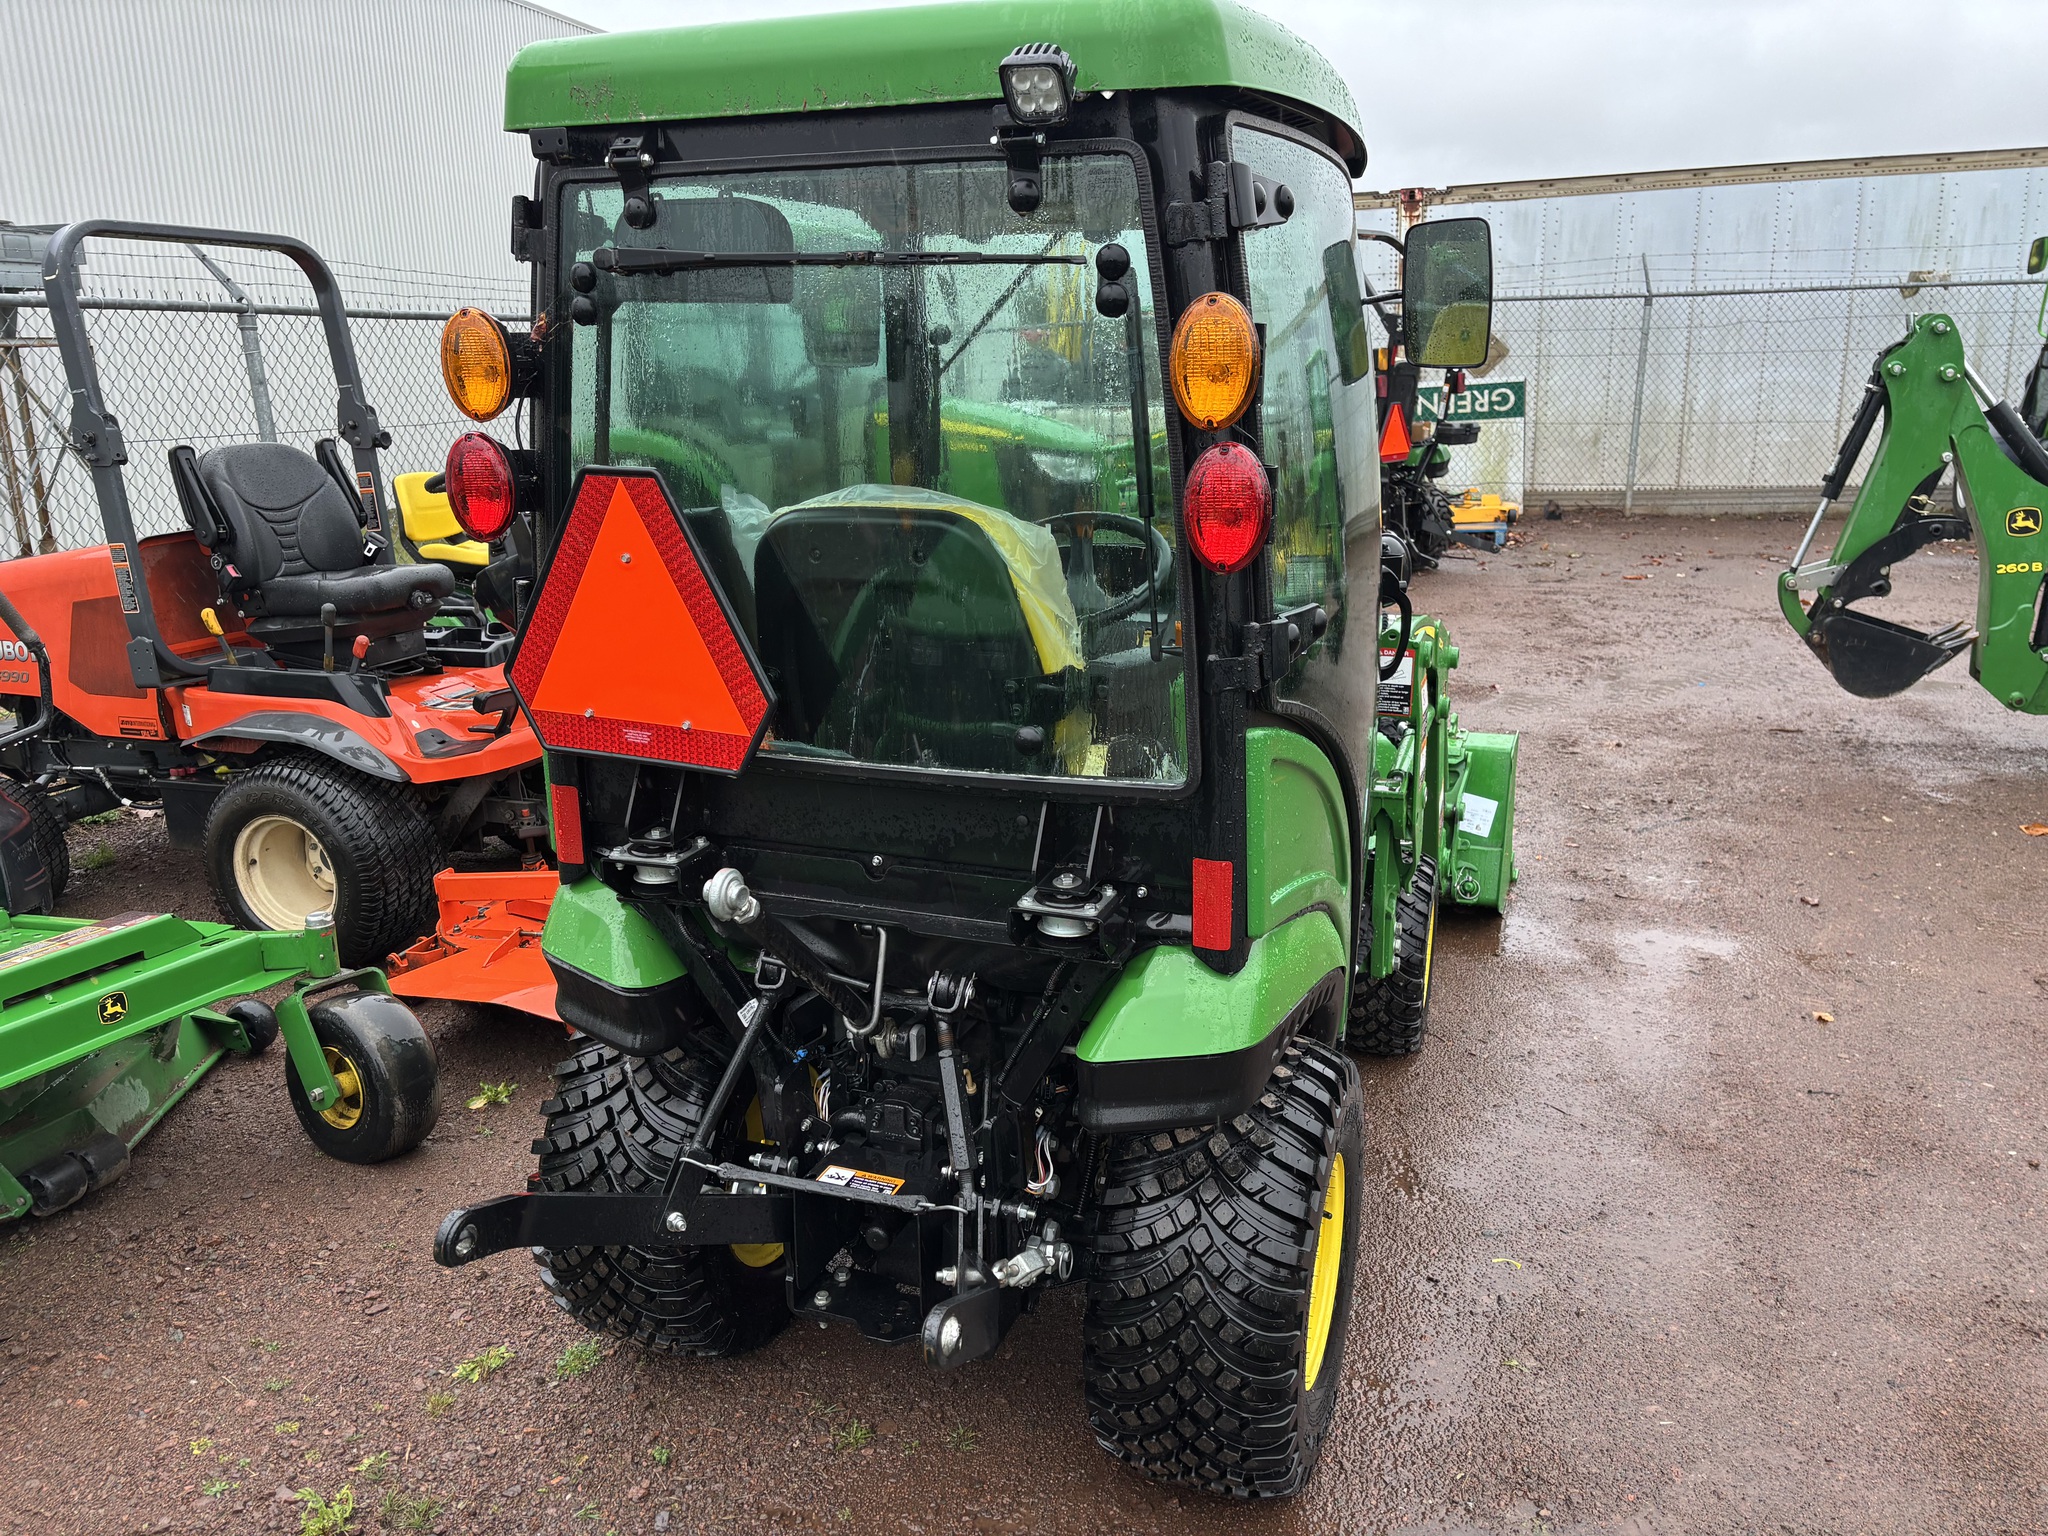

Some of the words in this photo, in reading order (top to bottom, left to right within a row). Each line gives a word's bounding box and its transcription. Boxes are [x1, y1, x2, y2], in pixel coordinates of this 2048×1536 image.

[1996, 563, 2029, 574] 260
[2032, 562, 2043, 572] B
[0, 670, 29, 683] 990
